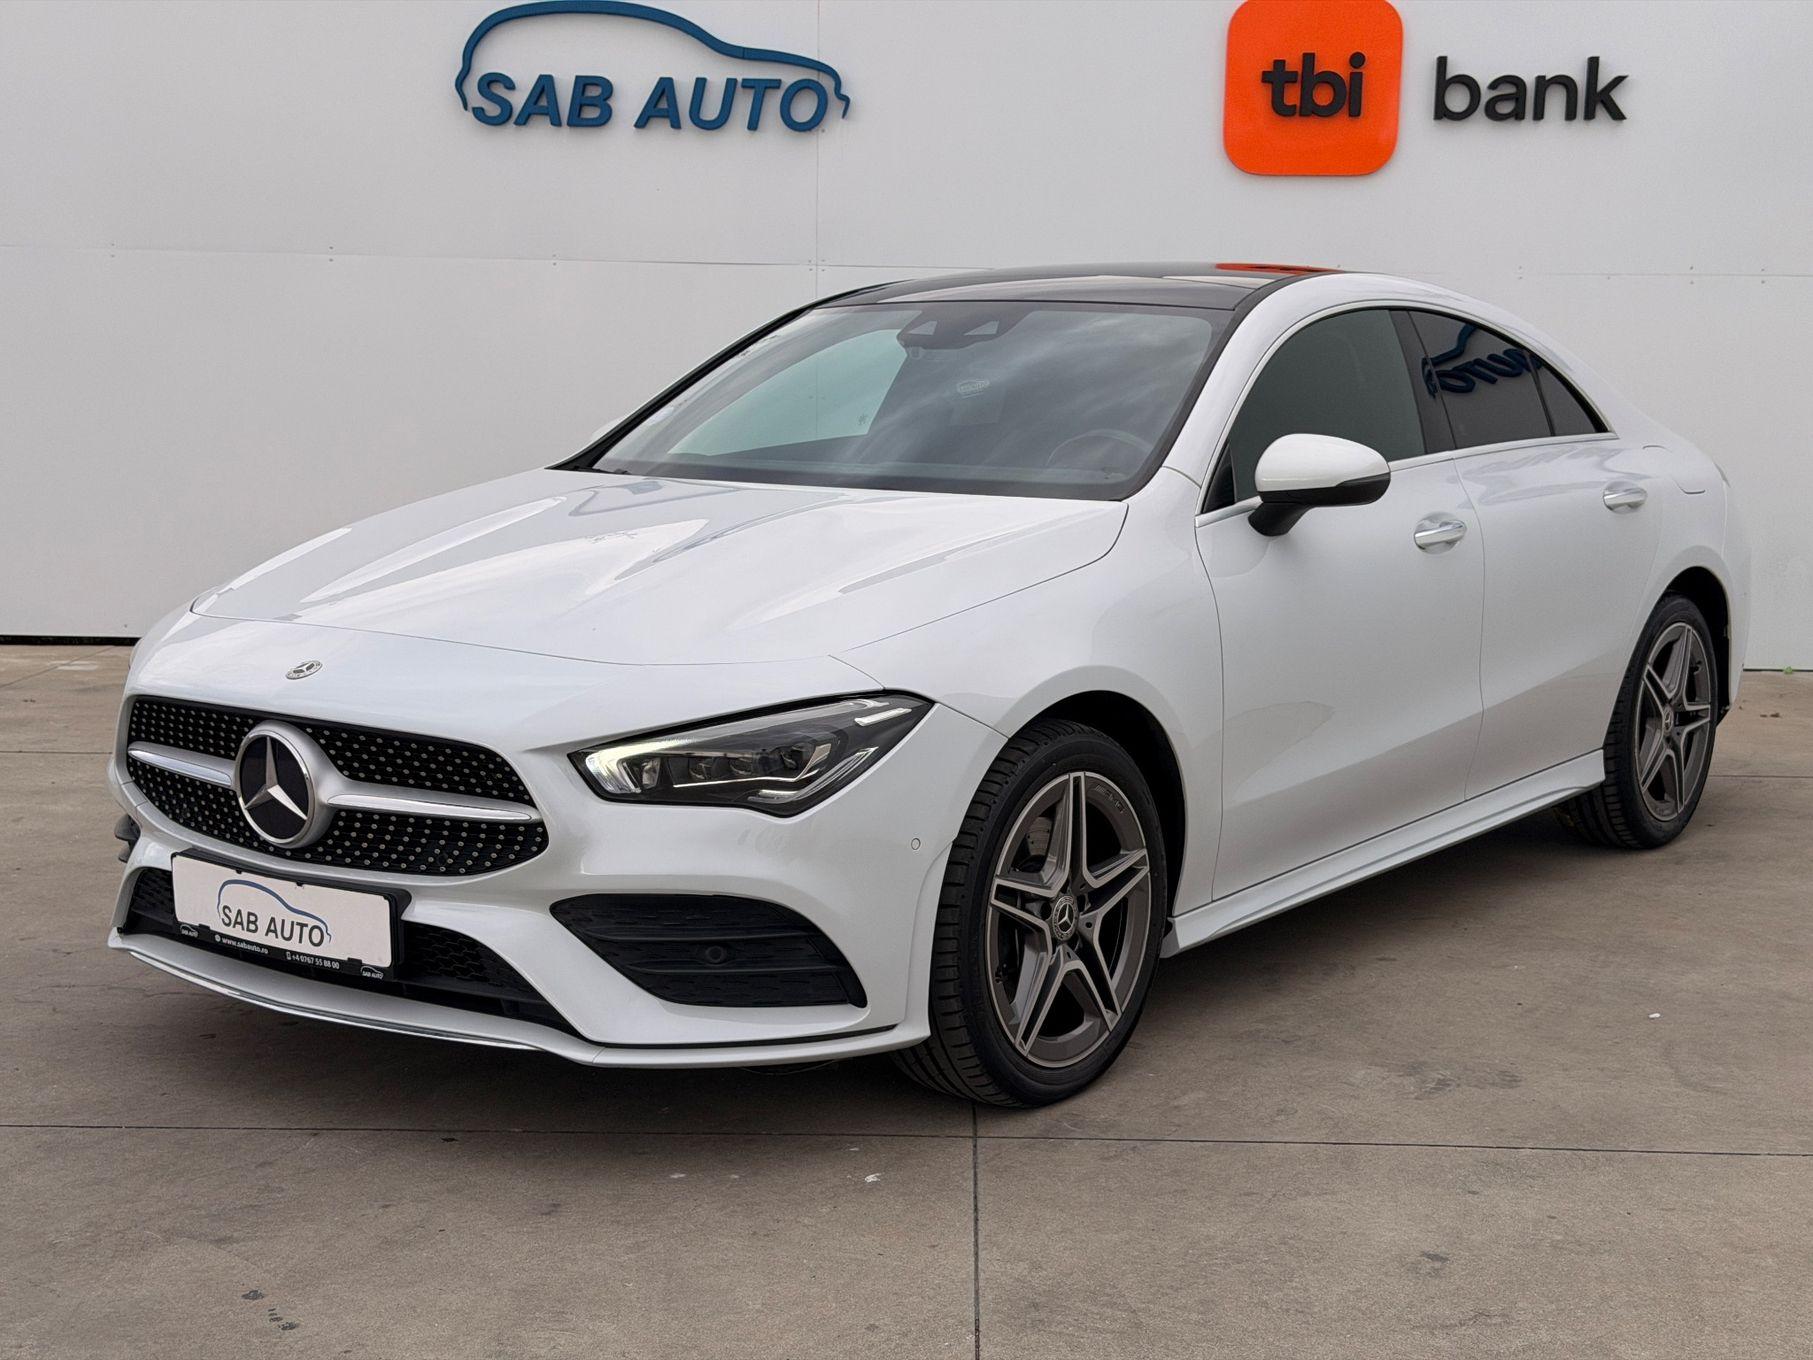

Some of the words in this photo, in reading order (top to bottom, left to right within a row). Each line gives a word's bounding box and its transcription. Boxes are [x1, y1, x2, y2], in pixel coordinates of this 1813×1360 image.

[472, 72, 614, 128] SAB
[634, 77, 829, 132] AUTO
[1262, 52, 1366, 119] tbi
[1433, 56, 1629, 121] bank
[221, 905, 259, 934] SAB
[265, 916, 325, 947] AUTO
